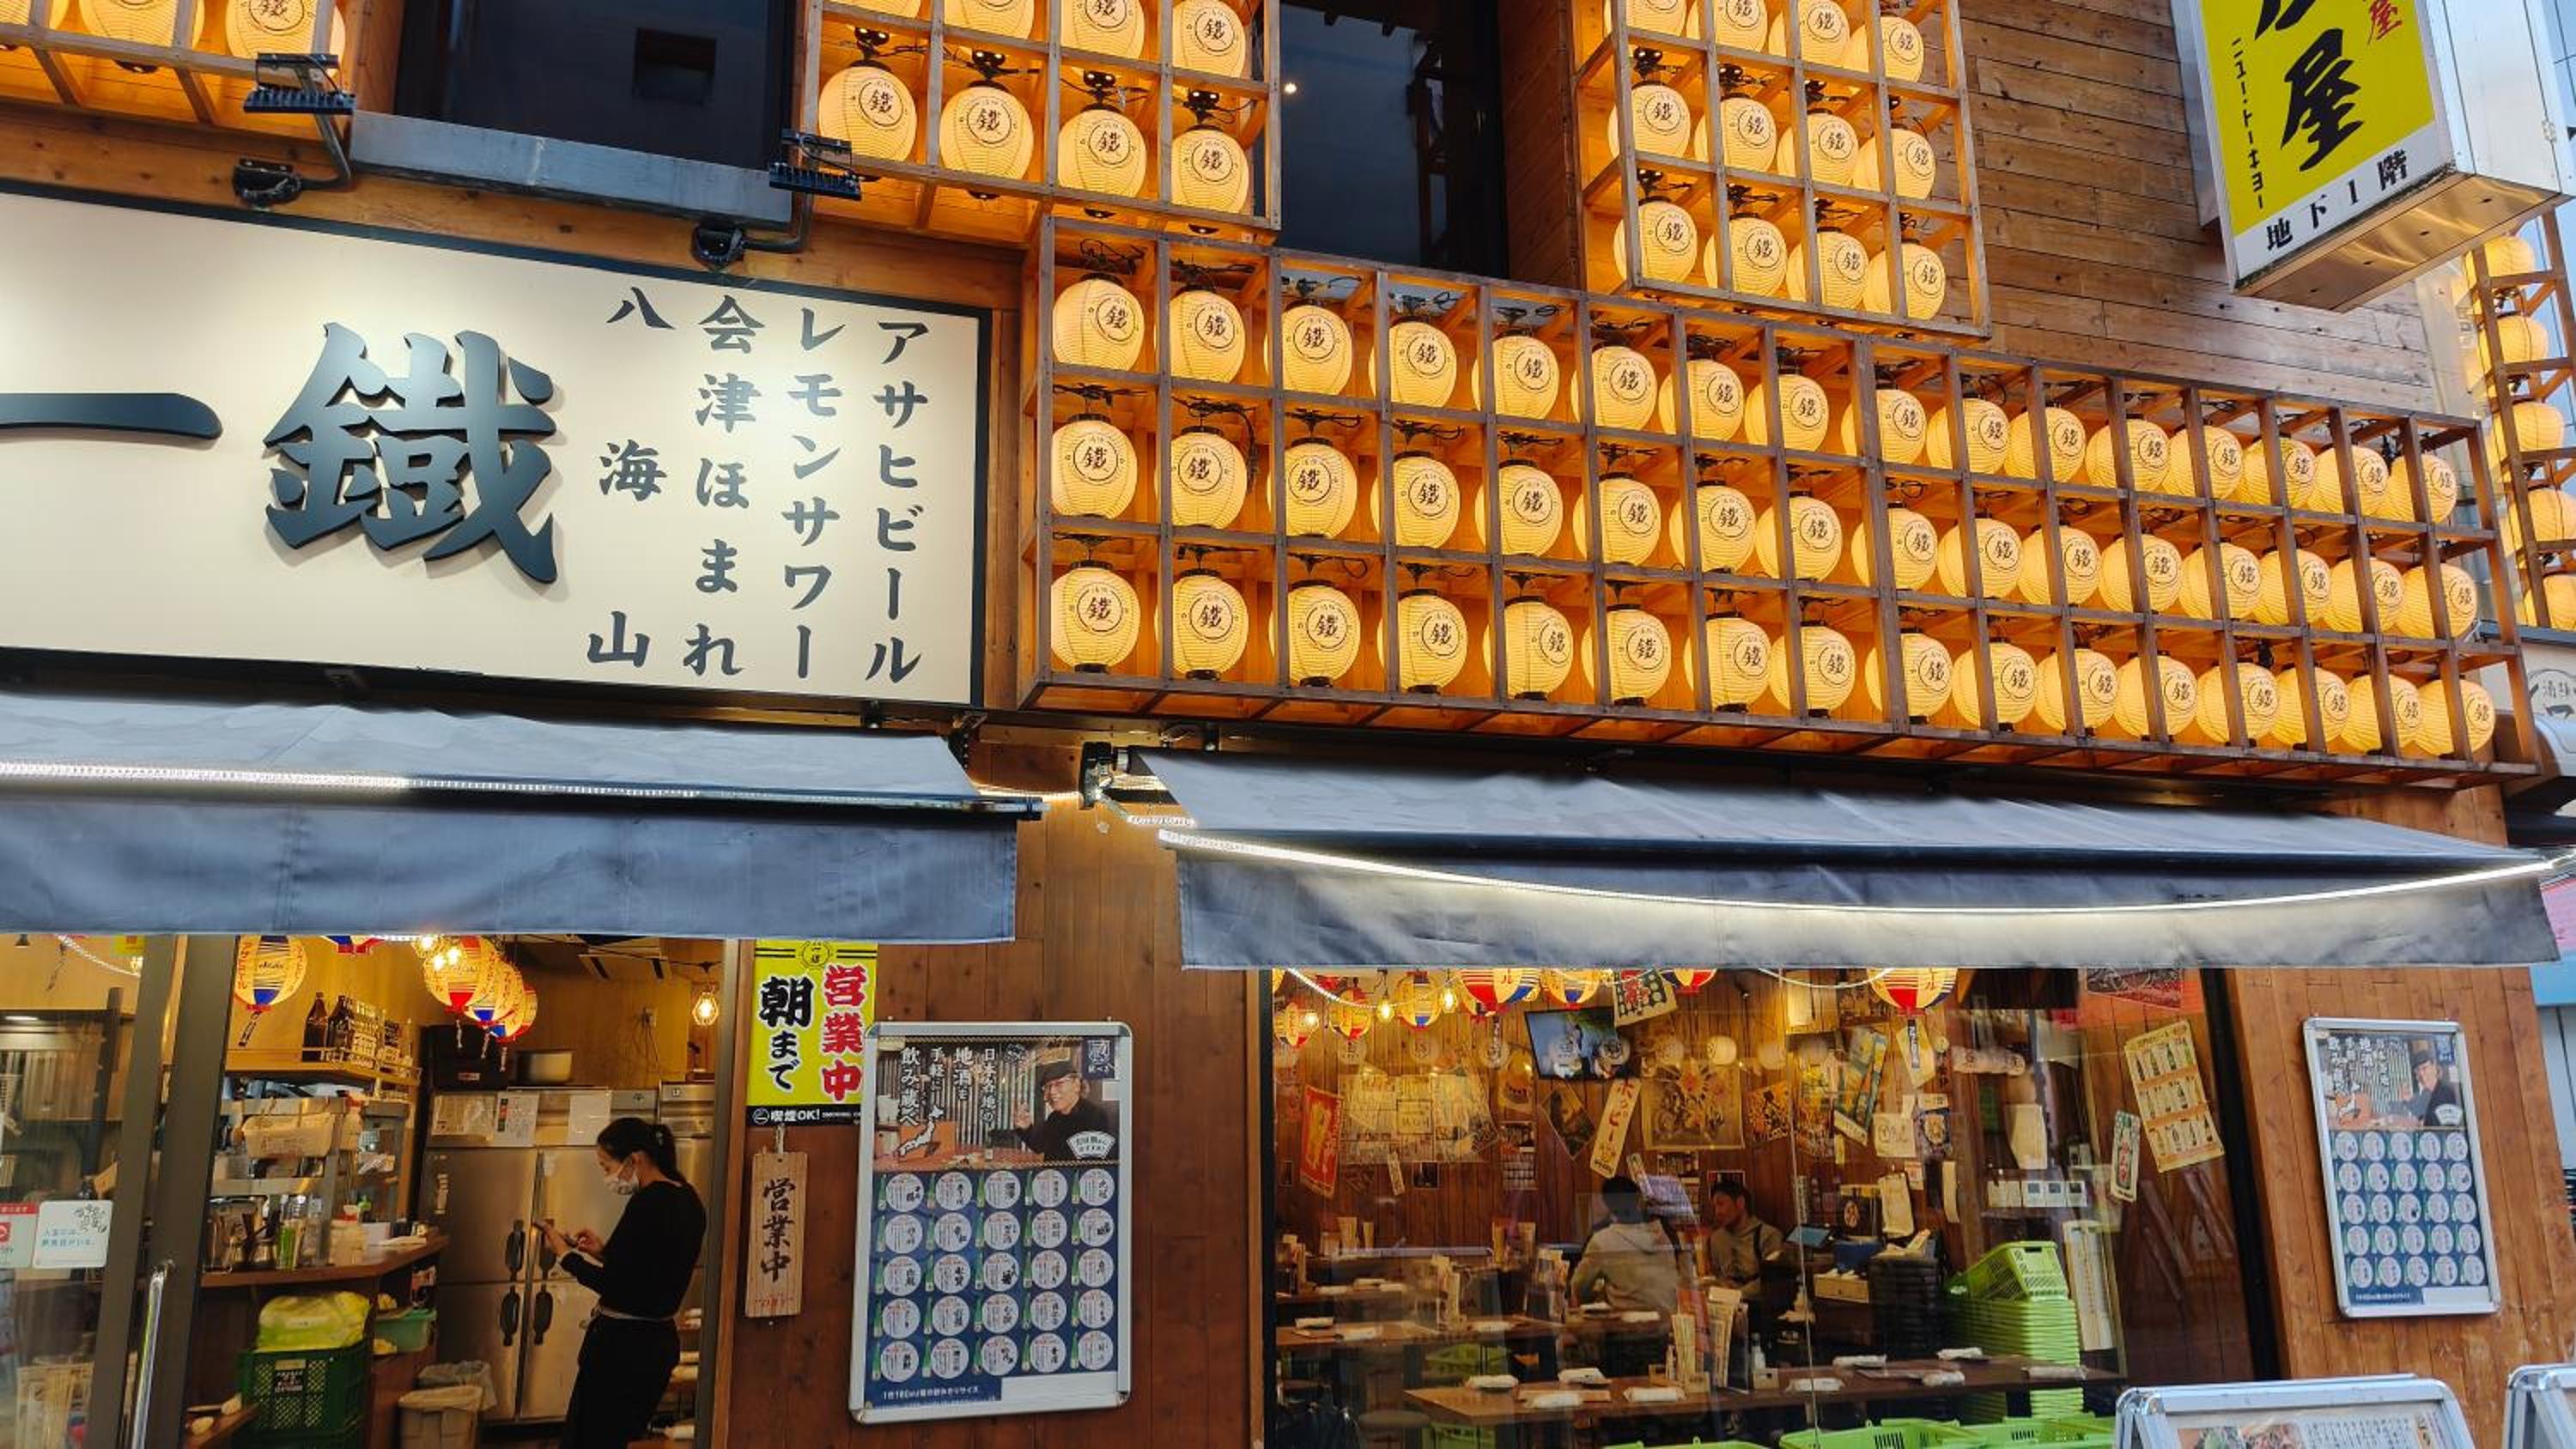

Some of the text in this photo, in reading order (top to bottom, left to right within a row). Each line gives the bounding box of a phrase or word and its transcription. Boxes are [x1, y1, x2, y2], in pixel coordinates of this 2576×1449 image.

[586, 286, 676, 668] 八海山
[683, 294, 765, 676] 会津ほまれ
[782, 307, 846, 679] レモンサワー
[866, 319, 929, 683] アサヒビール
[759, 976, 814, 1090] 朝まで
[822, 965, 866, 1101] 営業中
[761, 1178, 796, 1282] 営業中
